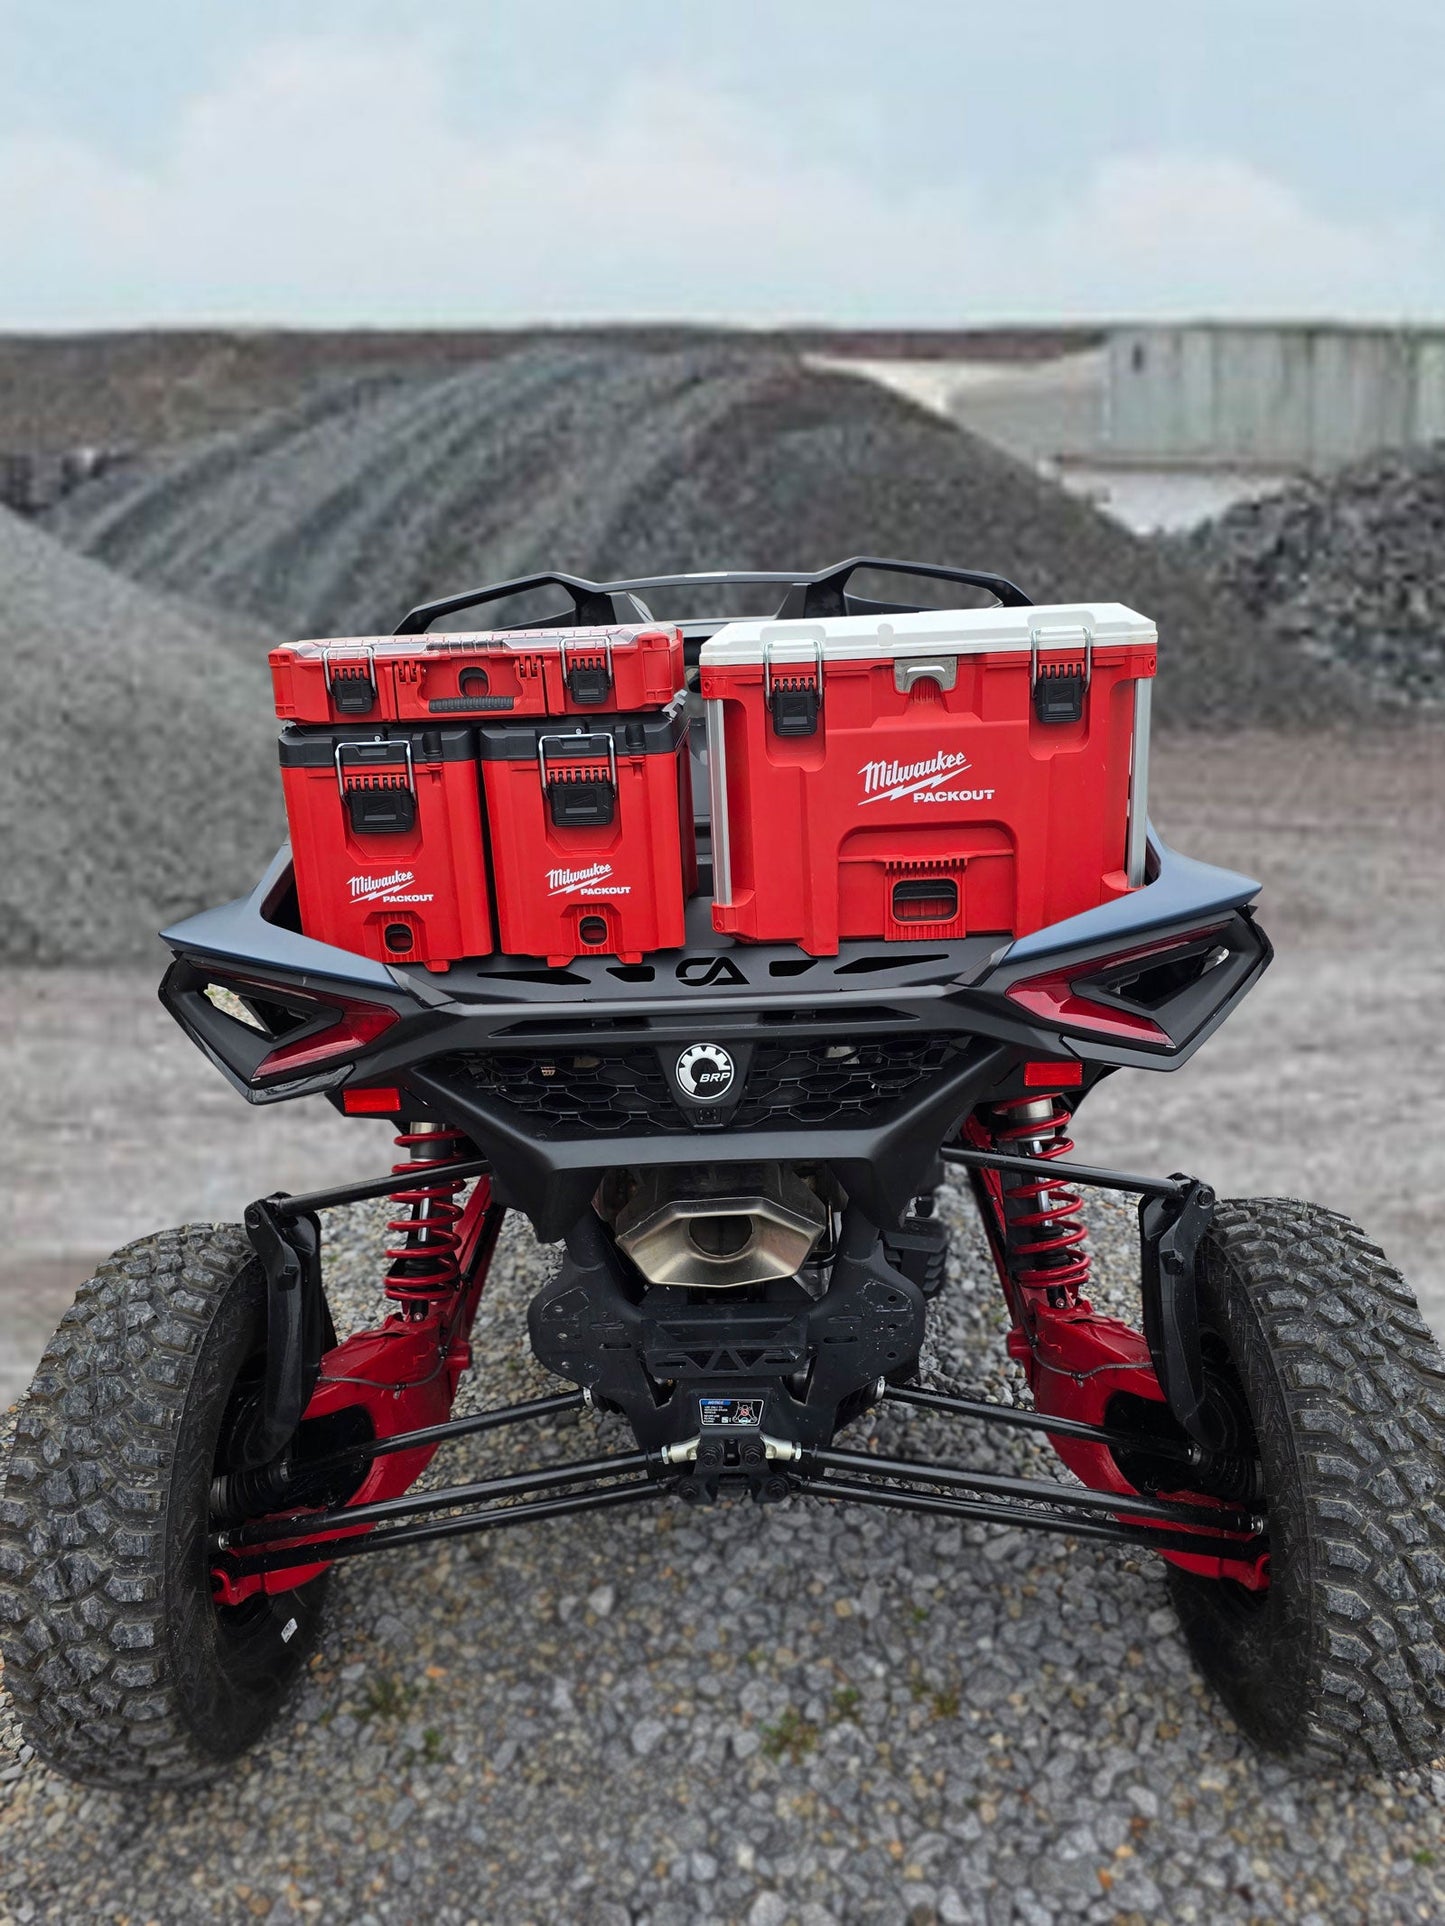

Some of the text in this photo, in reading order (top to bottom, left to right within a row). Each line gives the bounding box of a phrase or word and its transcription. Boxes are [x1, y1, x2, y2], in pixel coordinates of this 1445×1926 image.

[857, 751, 967, 794] Milwaukee
[913, 789, 995, 803] PACKOUT
[346, 869, 414, 897] Milwaukee
[545, 862, 612, 890] Milwaukee
[382, 893, 434, 903] PACKOUT
[580, 886, 631, 896] PACKOUT
[699, 1071, 731, 1084] BRP
